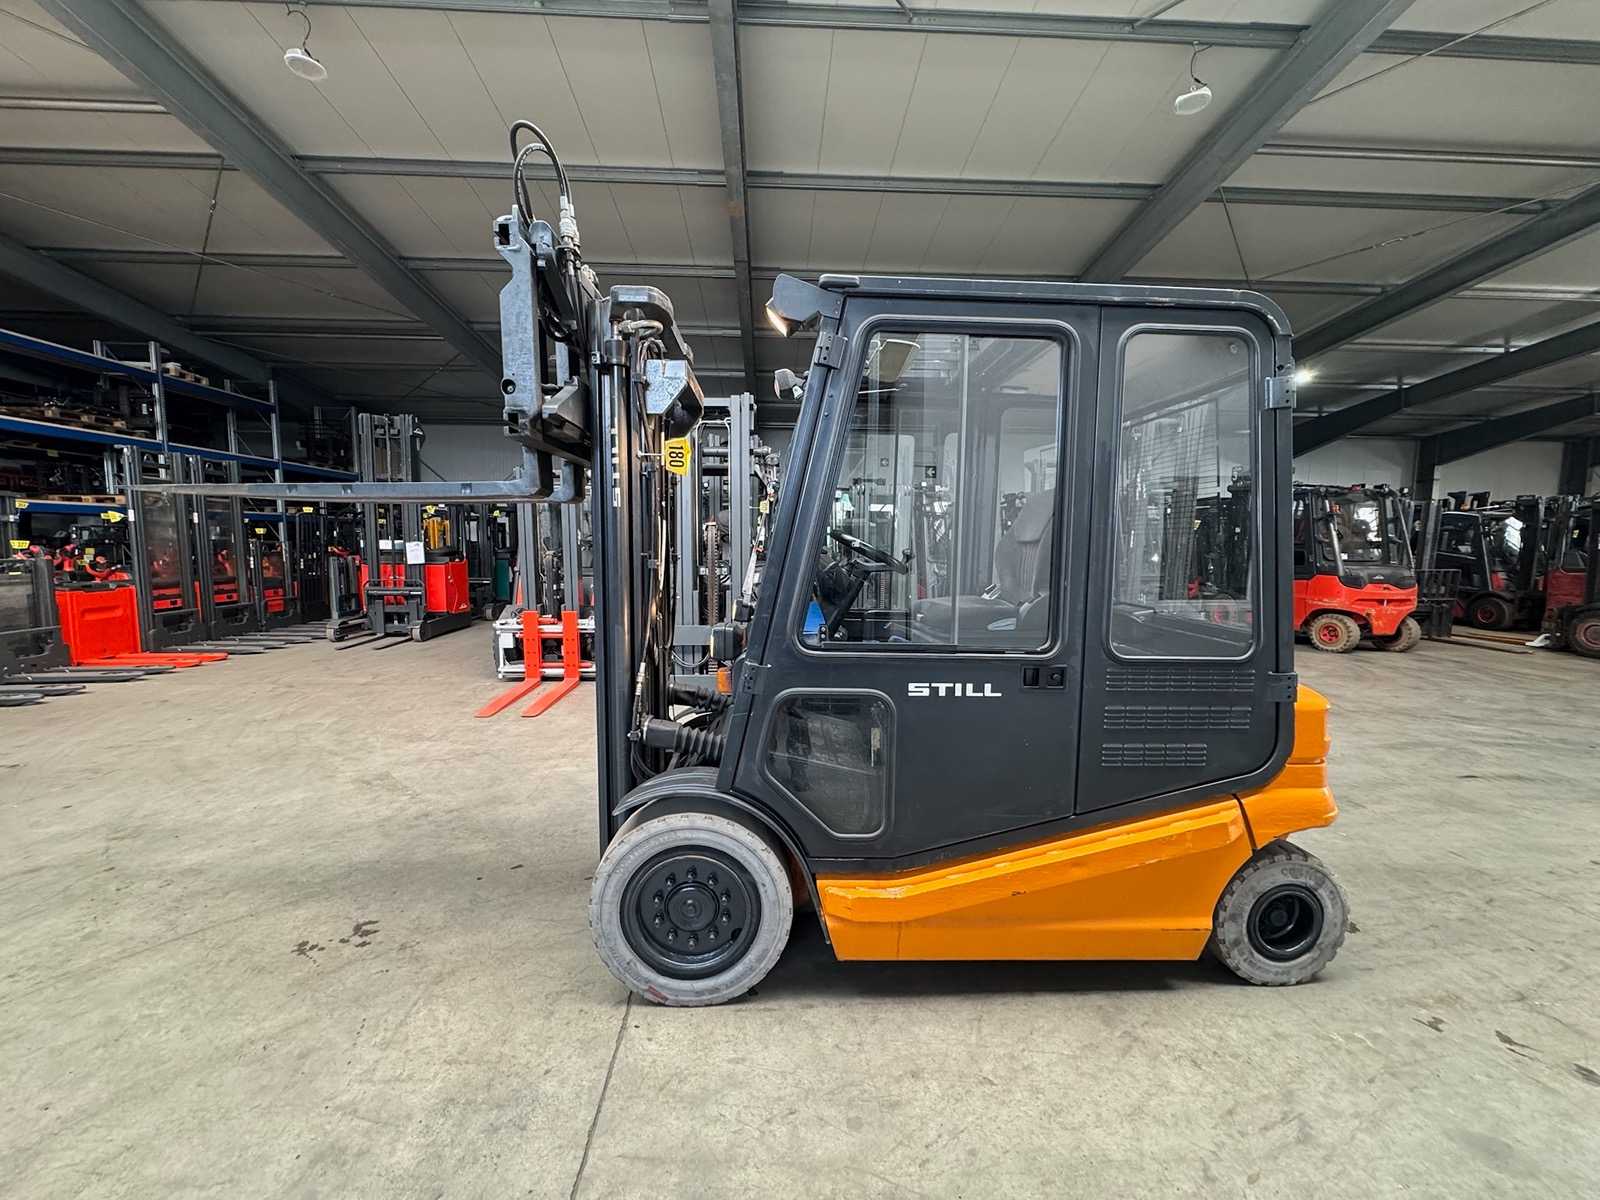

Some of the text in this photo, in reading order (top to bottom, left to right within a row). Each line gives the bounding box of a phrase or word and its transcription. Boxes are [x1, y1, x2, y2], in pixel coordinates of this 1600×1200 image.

[611, 417, 621, 508] STILL
[668, 445, 685, 468] 180
[907, 683, 1002, 697] STILL
